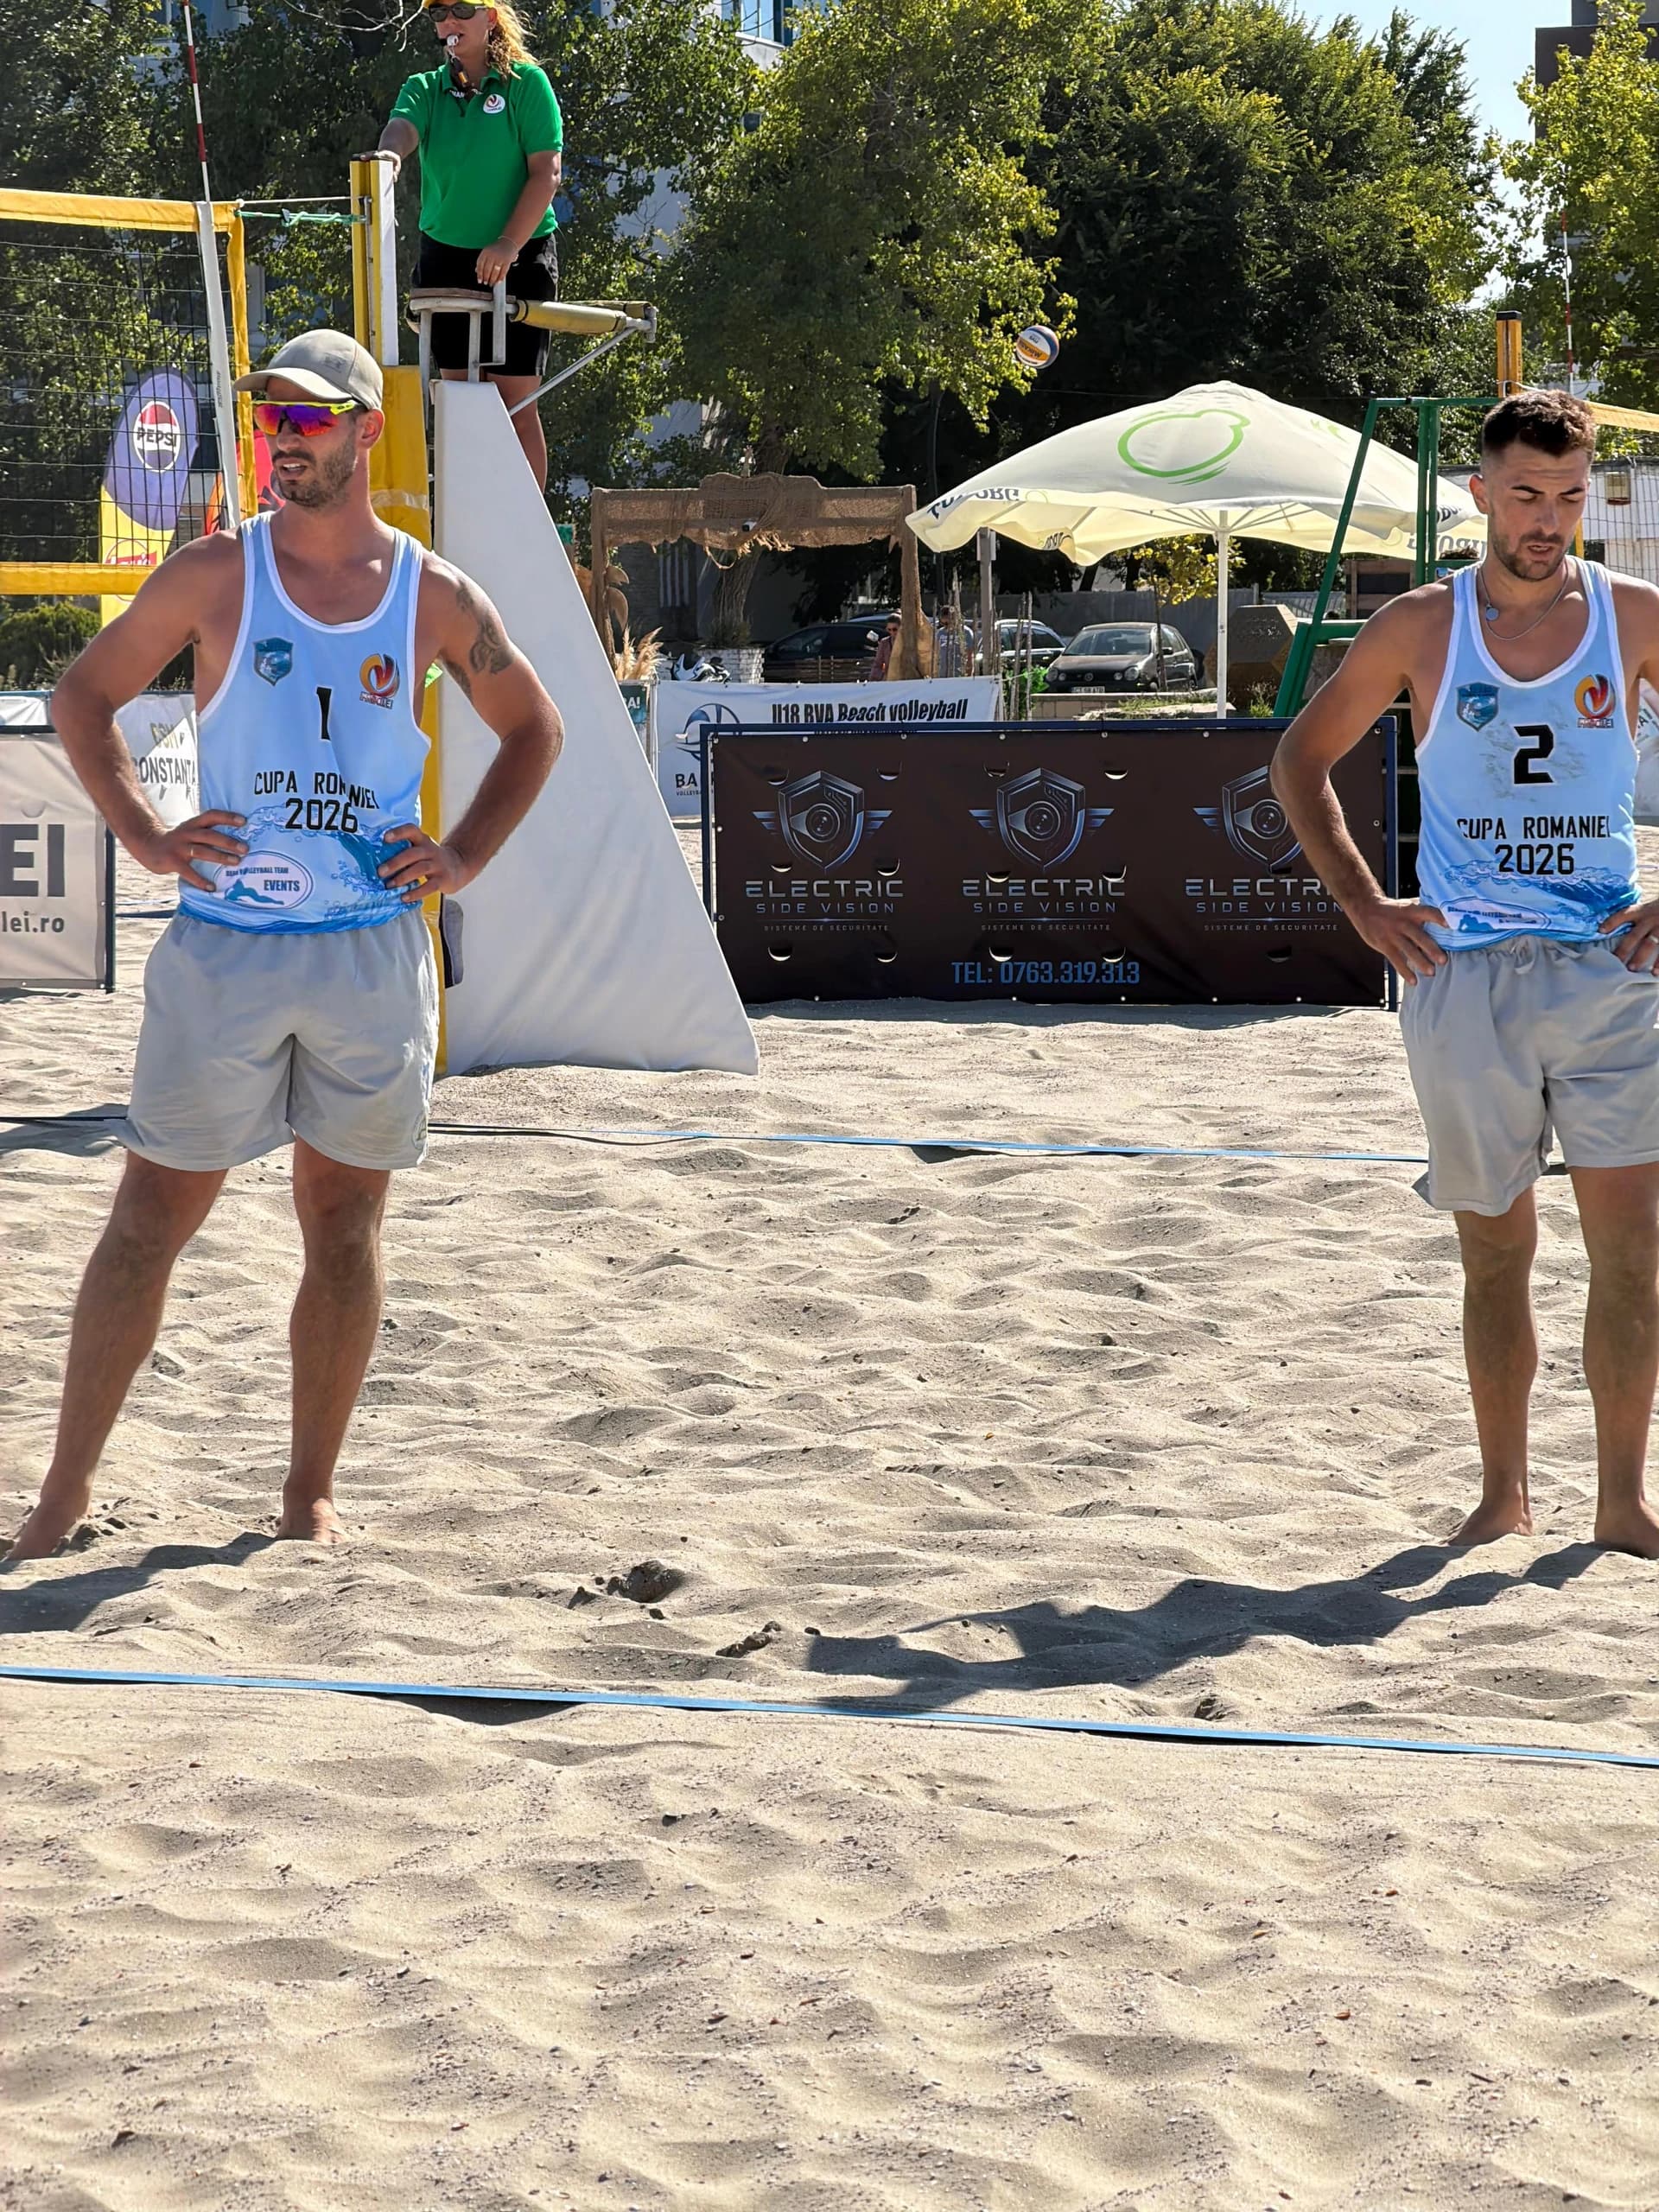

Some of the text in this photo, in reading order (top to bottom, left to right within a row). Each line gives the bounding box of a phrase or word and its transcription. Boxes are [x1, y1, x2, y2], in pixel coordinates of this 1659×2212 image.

[137, 427, 178, 448] PEPSI
[316, 686, 332, 741] 1
[837, 702, 887, 721] Beach
[890, 698, 969, 721] volleyball
[1513, 724, 1554, 785] 2
[254, 771, 298, 795] CUPA
[285, 798, 358, 833] 2026
[1457, 816, 1611, 840] CUPA ROMANIEI
[1494, 843, 1574, 875] 2026
[264, 880, 300, 892] EVENTS
[746, 880, 904, 898] ELECTRIC
[963, 879, 1126, 897] ELECTRIC
[756, 903, 894, 913] SIDE VISION
[974, 902, 1116, 912] SIDE VISION
[1197, 902, 1249, 912] SIDE
[2, 911, 65, 933] lei.ro
[951, 961, 1140, 984] TEL: 0763.319.313
